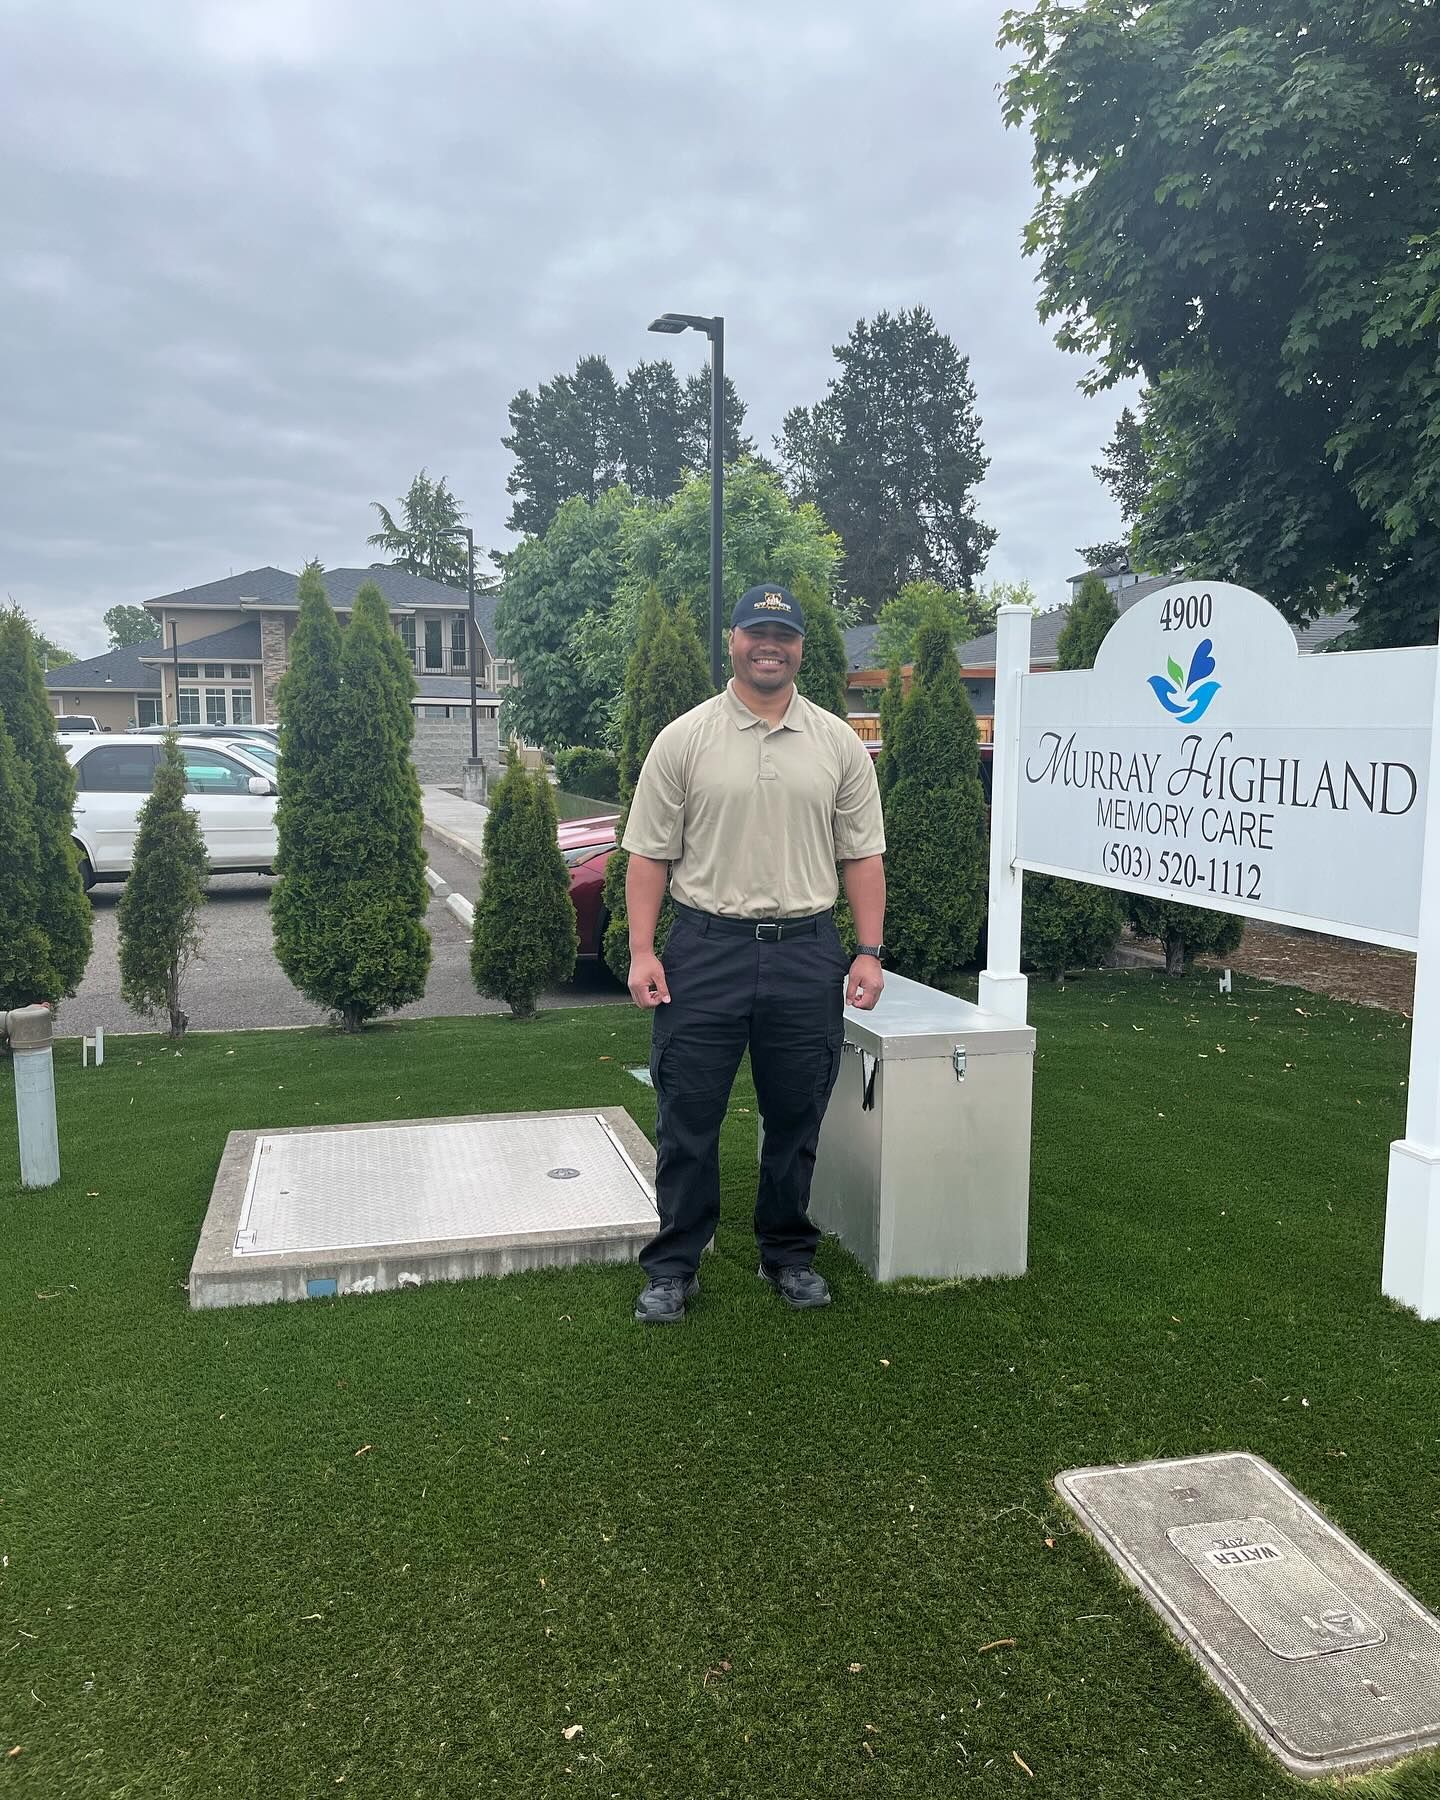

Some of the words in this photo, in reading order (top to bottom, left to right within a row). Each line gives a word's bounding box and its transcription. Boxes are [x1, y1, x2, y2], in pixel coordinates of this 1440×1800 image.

[1159, 593, 1213, 632] 4900
[1025, 731, 1162, 794] MURRAY
[1167, 731, 1418, 815] HIGHLAND
[1097, 797, 1195, 839] MEMORY
[1201, 807, 1275, 850] CARE
[1102, 841, 1152, 881] (503)
[1158, 850, 1262, 901] 520-1112
[1213, 1546, 1279, 1565] WATER
